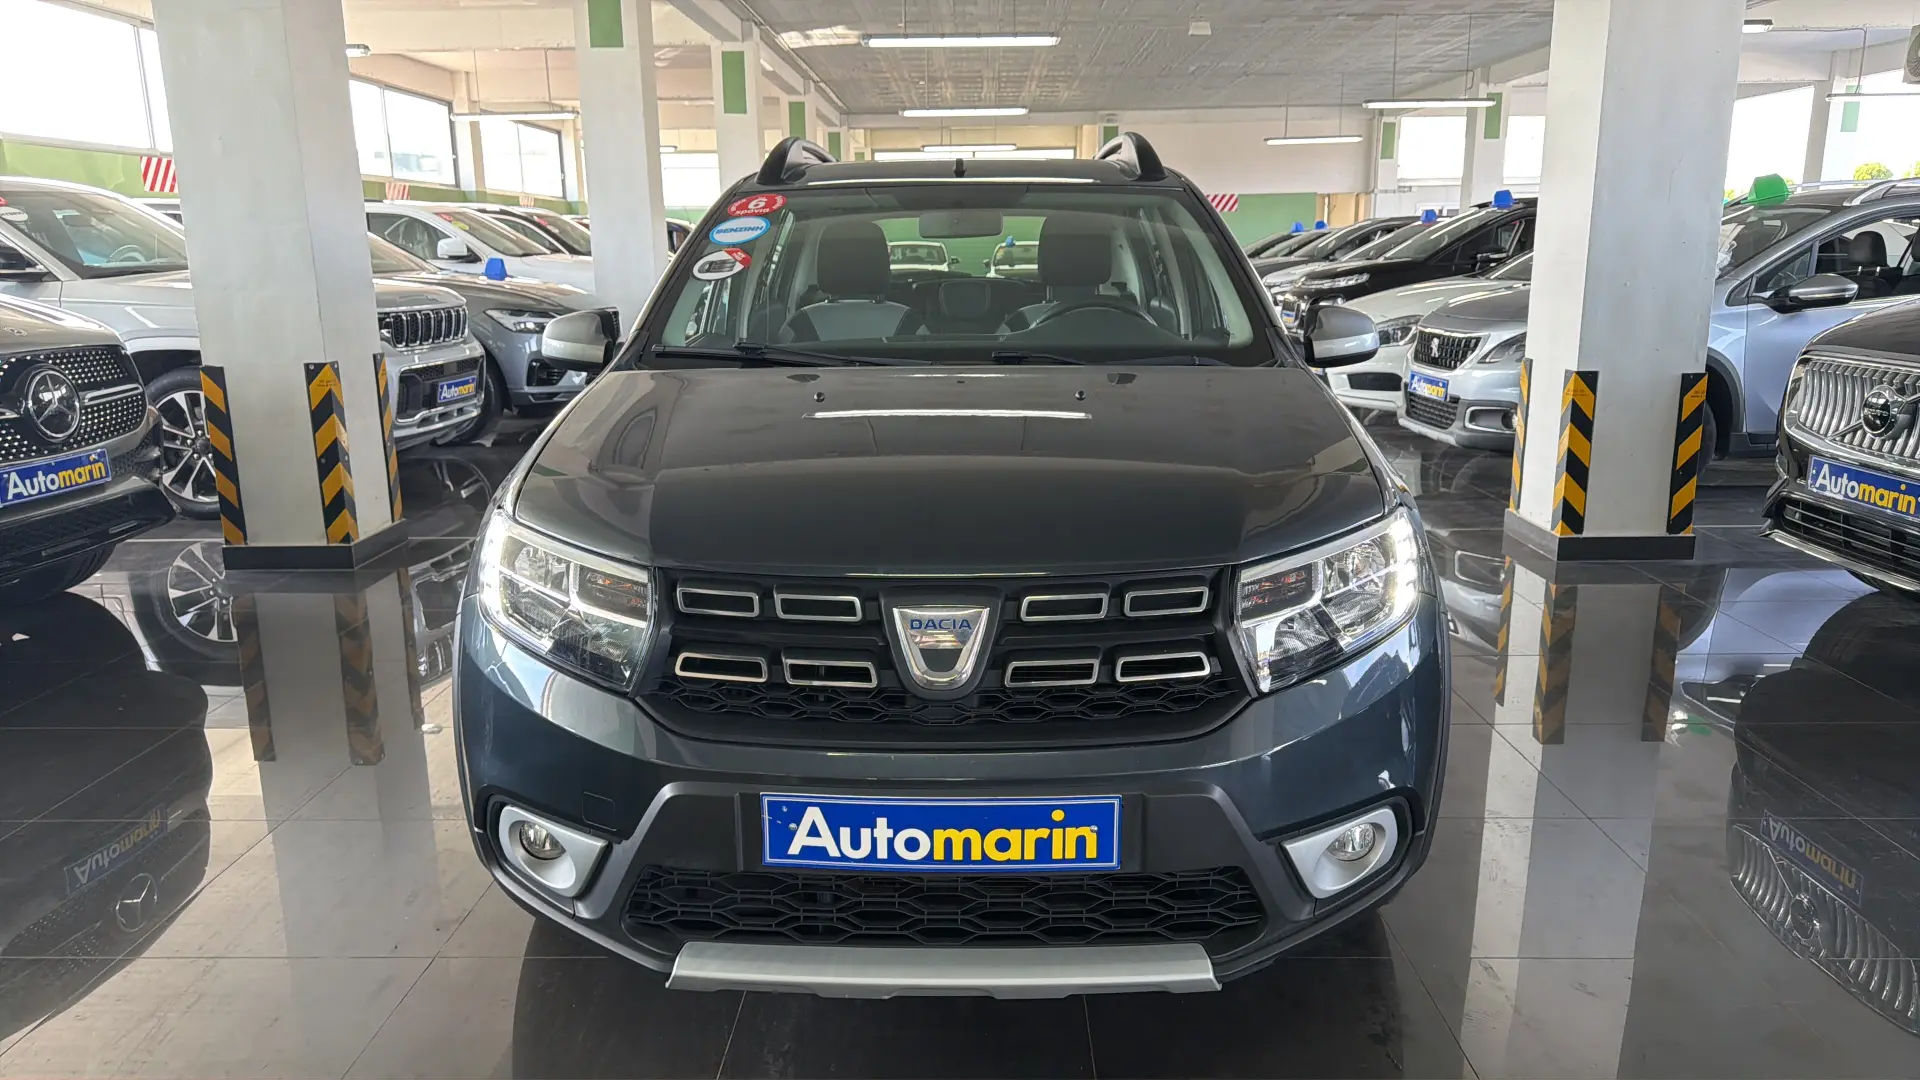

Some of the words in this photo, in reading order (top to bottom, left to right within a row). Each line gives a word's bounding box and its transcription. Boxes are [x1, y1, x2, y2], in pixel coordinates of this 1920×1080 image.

[748, 198, 768, 209] 6
[7, 454, 106, 500] Automarin
[1815, 464, 1916, 514] Automarin
[910, 619, 972, 630] DACIA
[787, 806, 1097, 861] Automarin
